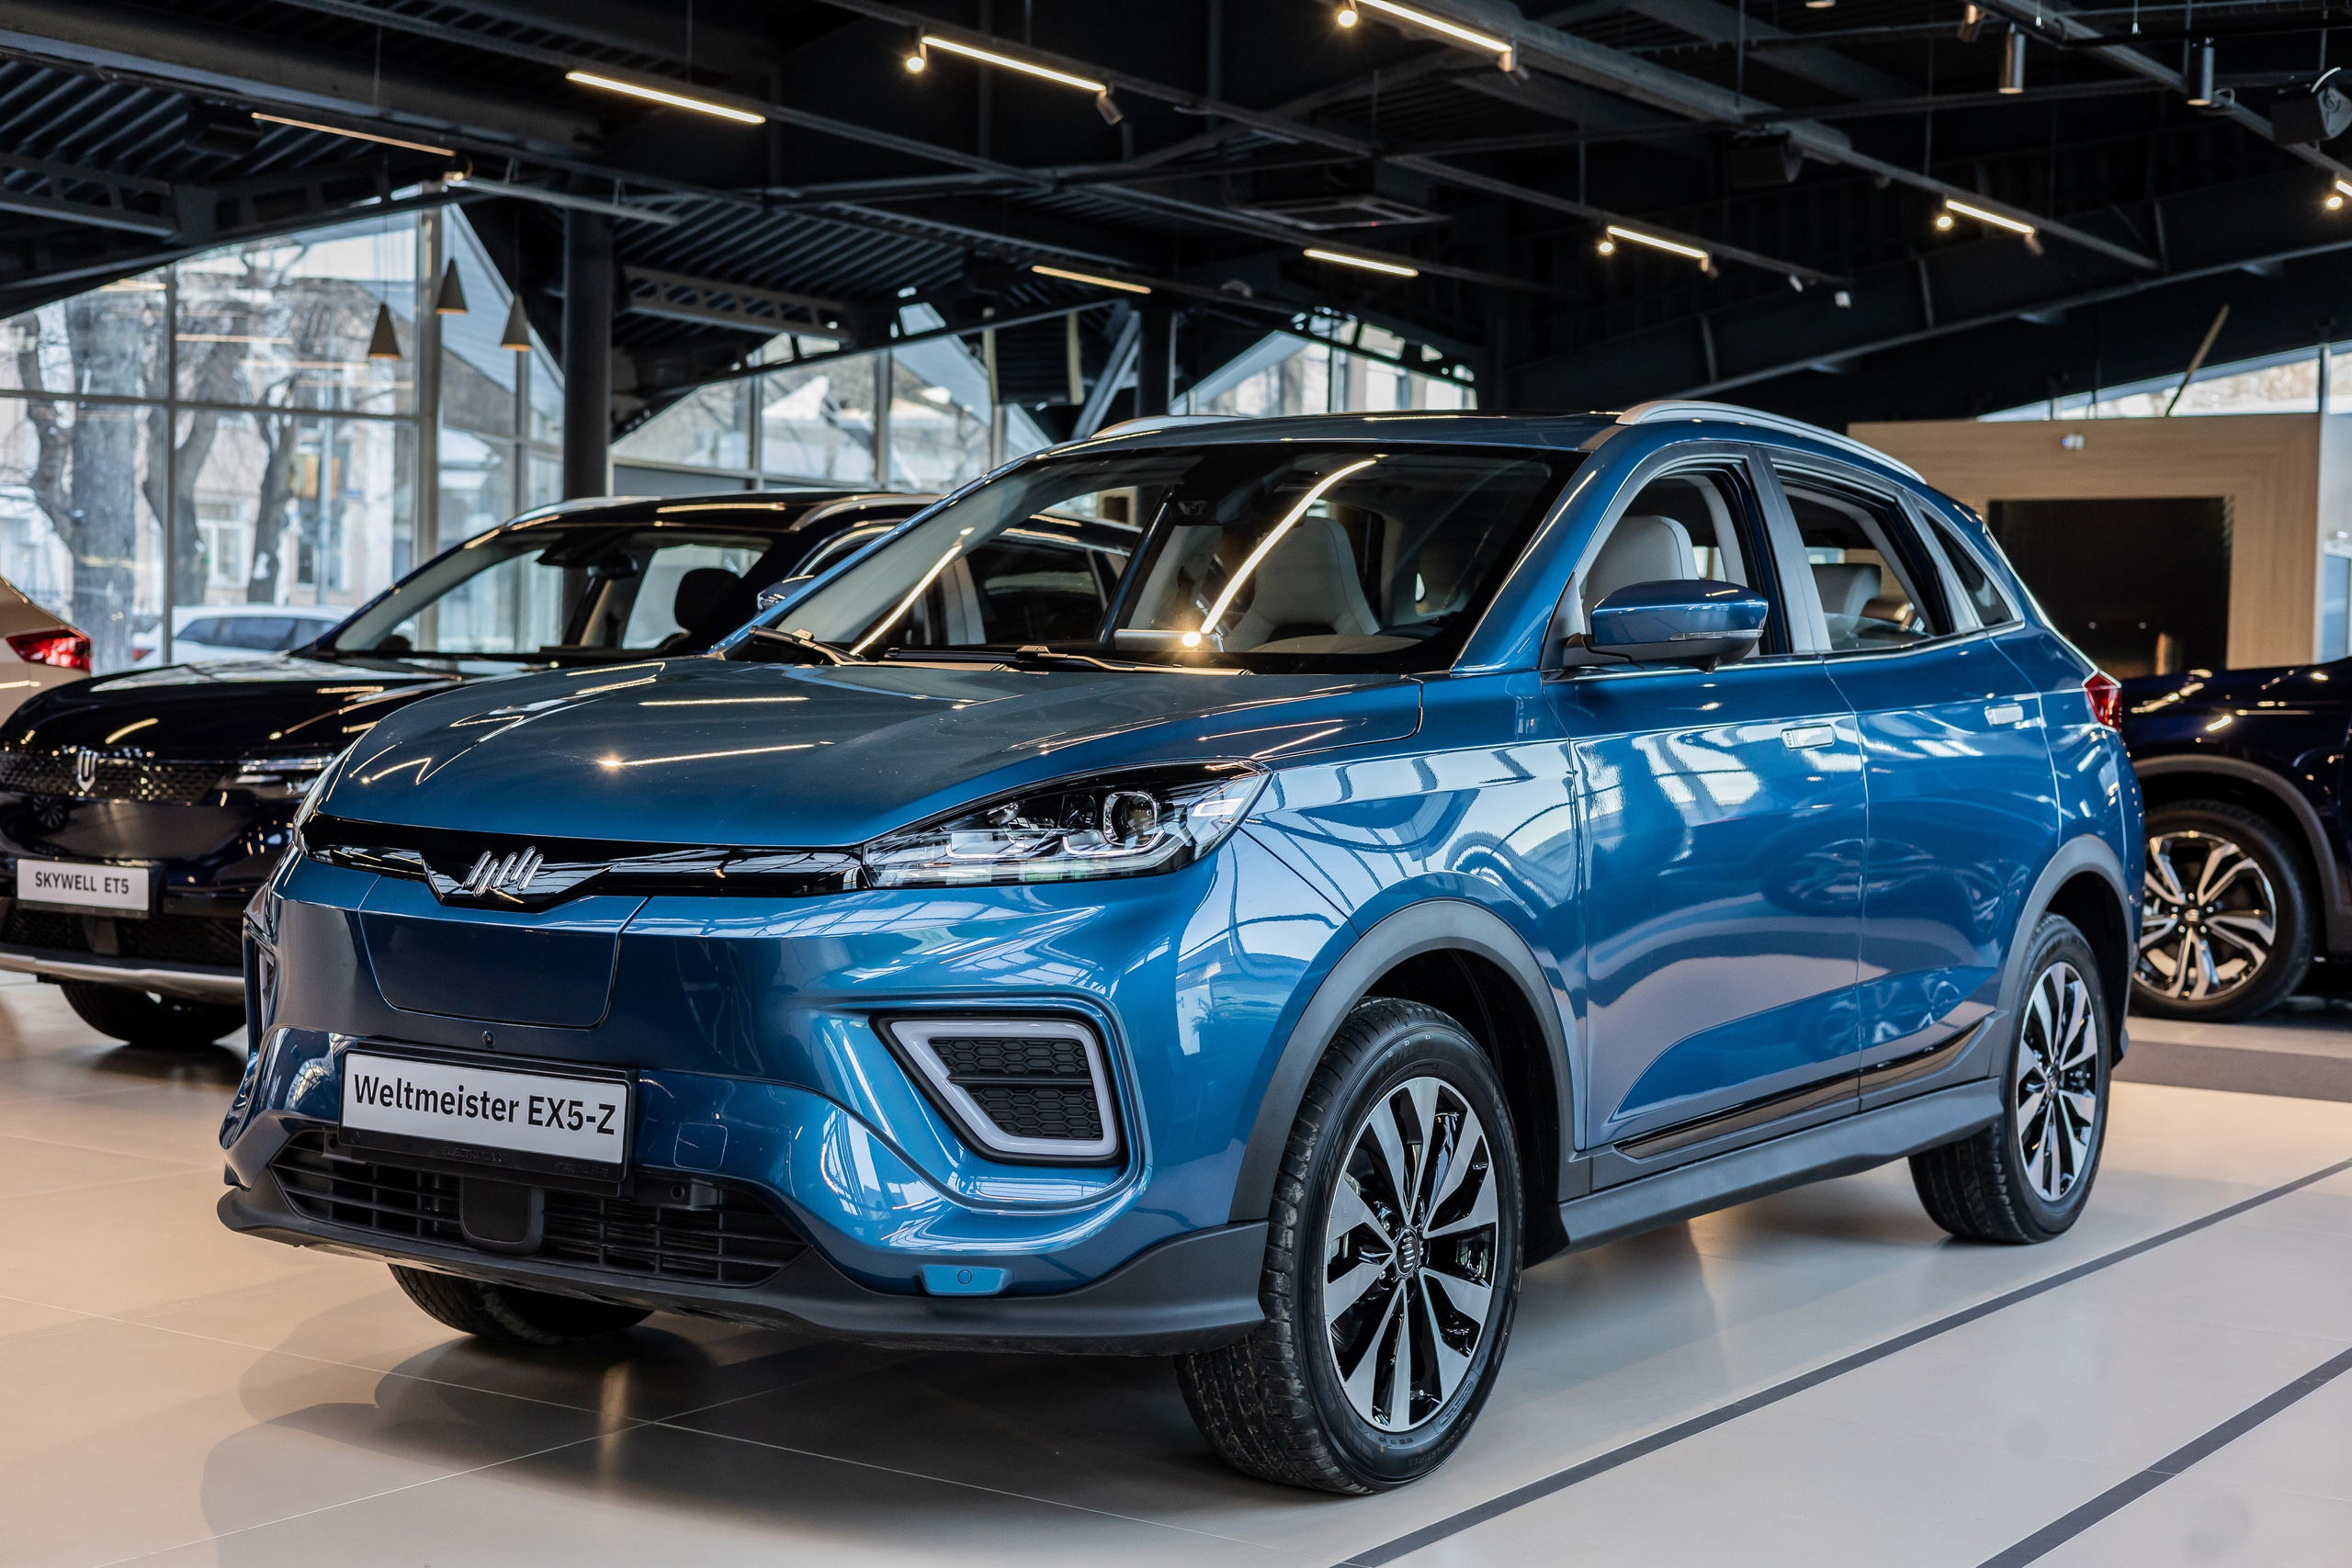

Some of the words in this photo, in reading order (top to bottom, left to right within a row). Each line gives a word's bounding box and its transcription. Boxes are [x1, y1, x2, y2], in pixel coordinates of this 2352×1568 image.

[35, 872, 97, 892] SKYWELL
[104, 876, 130, 895] ET5
[354, 1073, 520, 1123] Weltmeister
[527, 1094, 616, 1135] EX5-Z
[1406, 1428, 1460, 1468] COOPERTIRES
